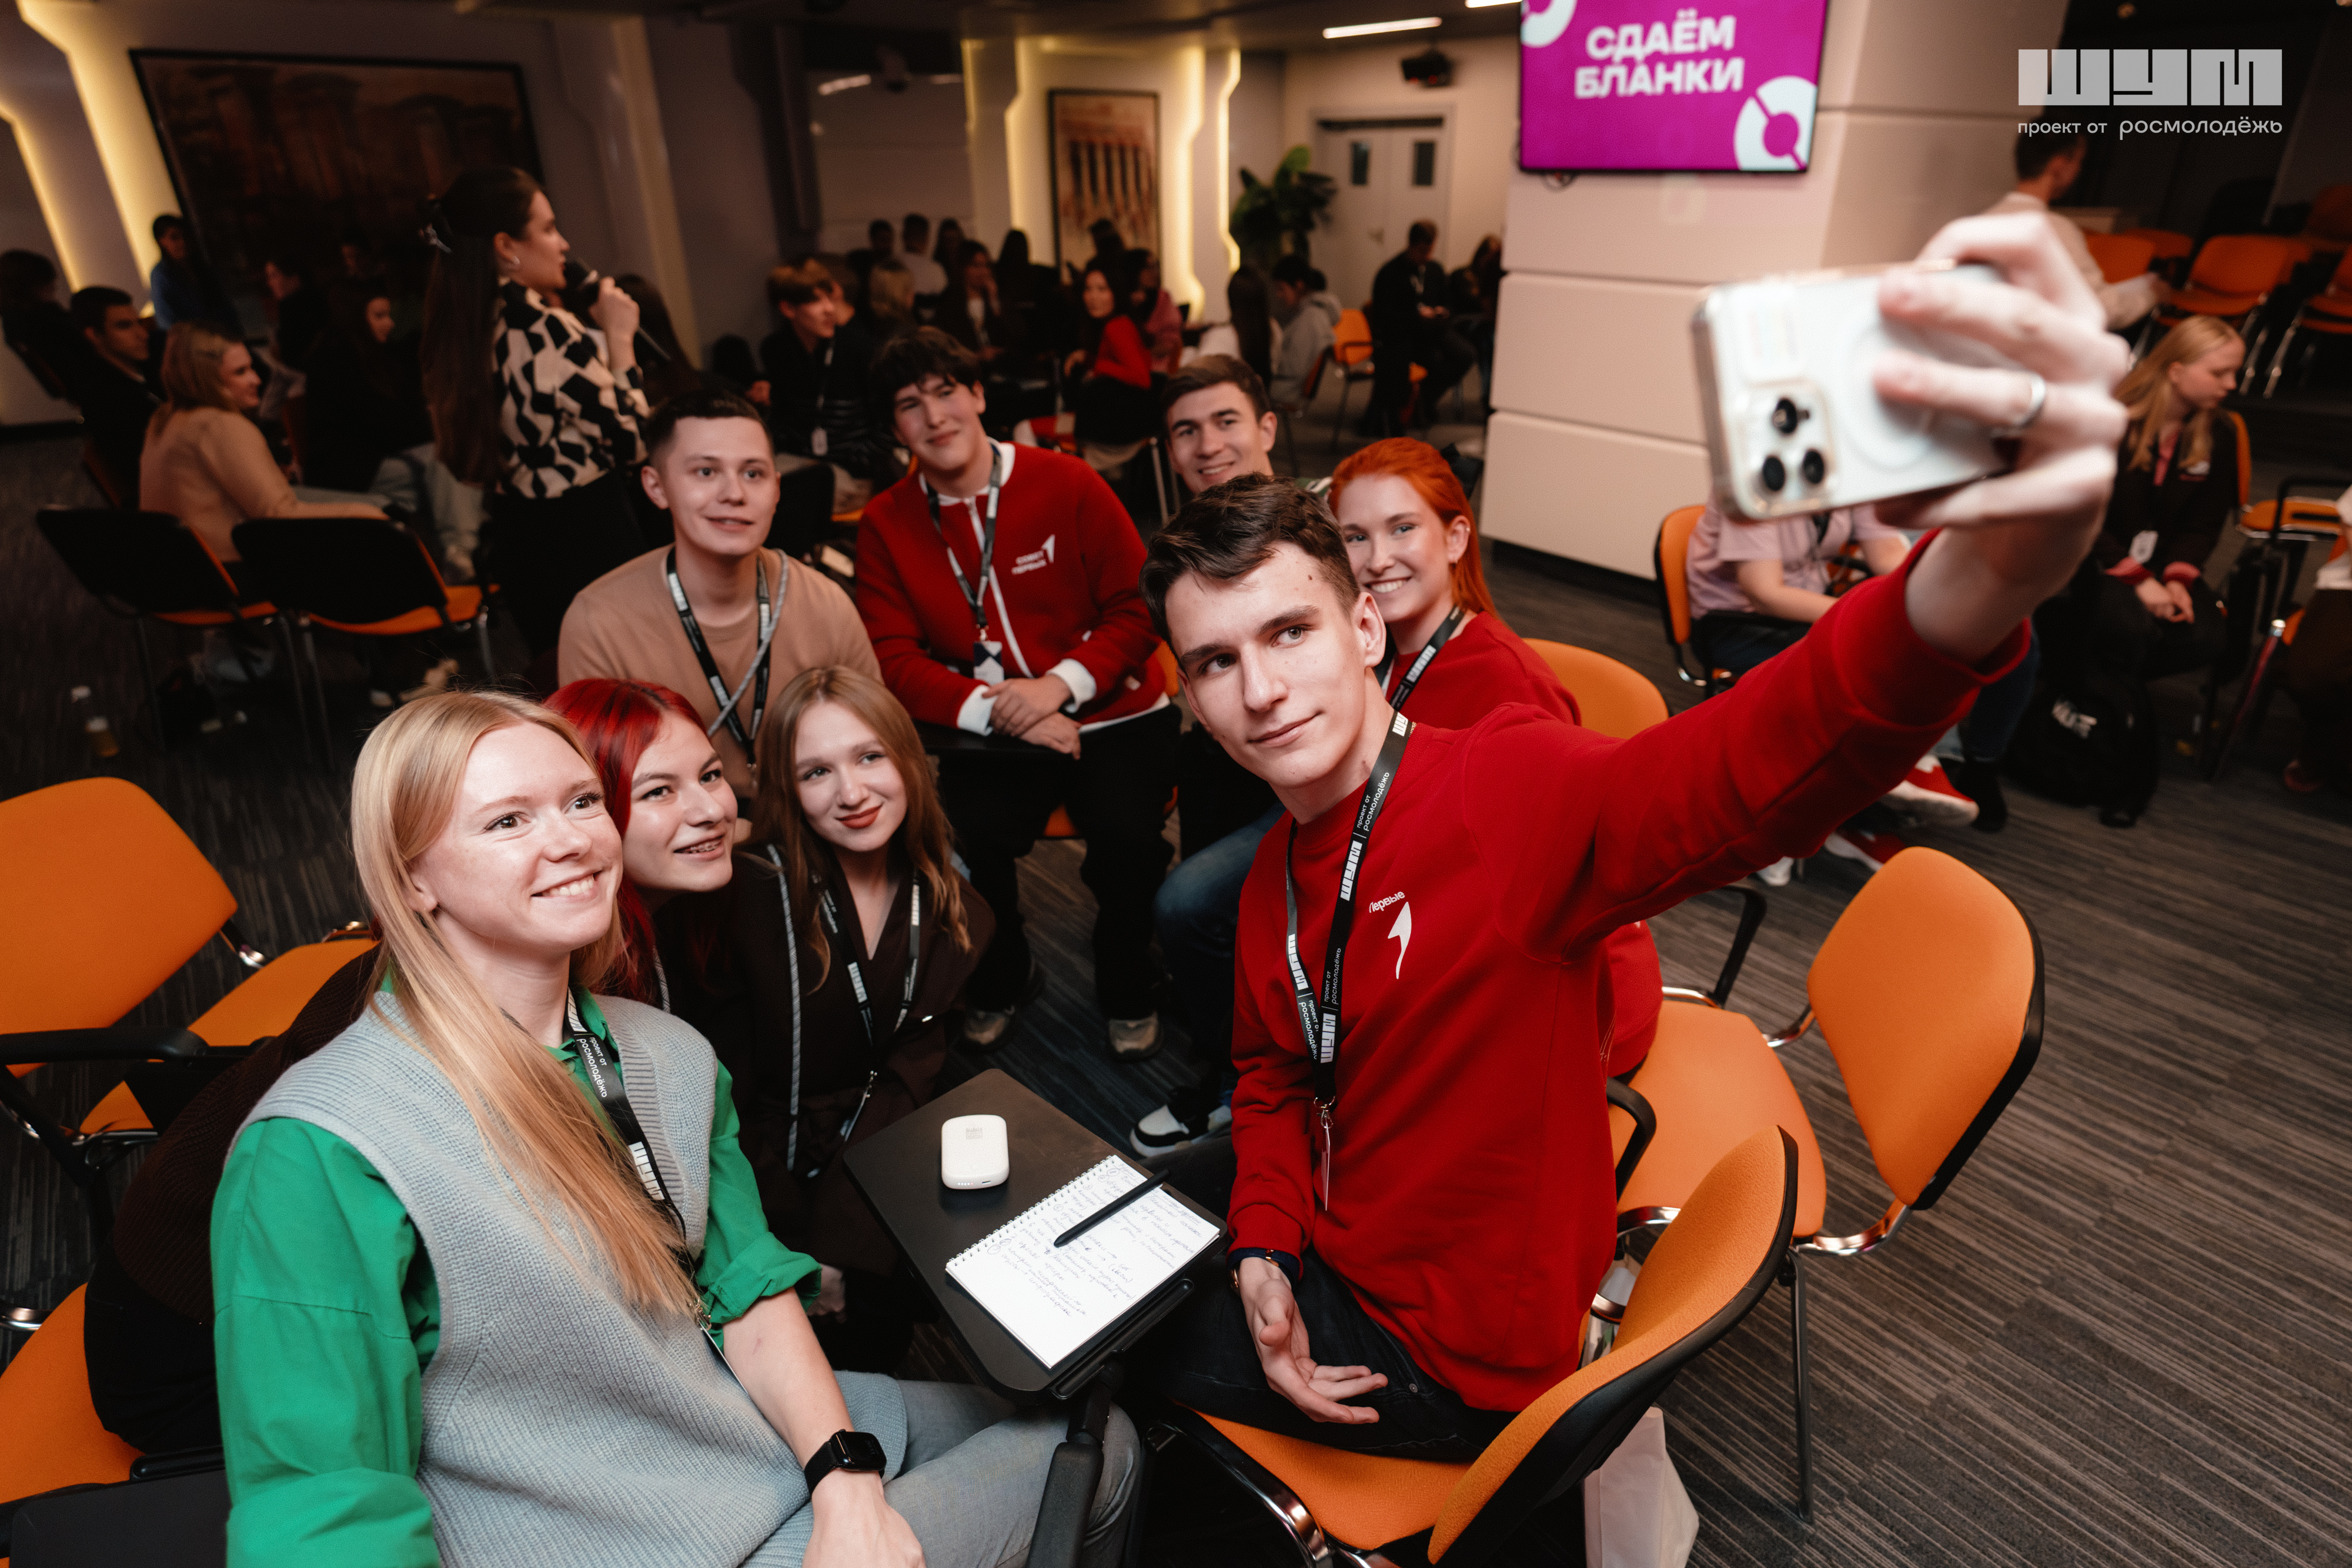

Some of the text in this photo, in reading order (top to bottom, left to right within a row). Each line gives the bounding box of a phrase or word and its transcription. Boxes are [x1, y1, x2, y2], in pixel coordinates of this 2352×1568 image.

[1586, 8, 1736, 63] СДАЁМ
[1574, 57, 1745, 99] БЛАНКИ
[1392, 711, 1408, 737] ШУ
[1357, 795, 1371, 828] проект от
[1364, 772, 1389, 831] росмолодёжь
[1340, 840, 1362, 901] ШУМ
[1369, 891, 1405, 913] Первые
[1288, 934, 1308, 990] ШУМ
[1327, 971, 1331, 979] от
[1331, 948, 1341, 1005] росмолодёжь
[1309, 1000, 1318, 1023] проект
[590, 1037, 603, 1057] проект
[1321, 1013, 1336, 1064] ШУМ
[576, 1038, 607, 1098] росмолодёжь
[628, 1141, 665, 1200] ШУМ
